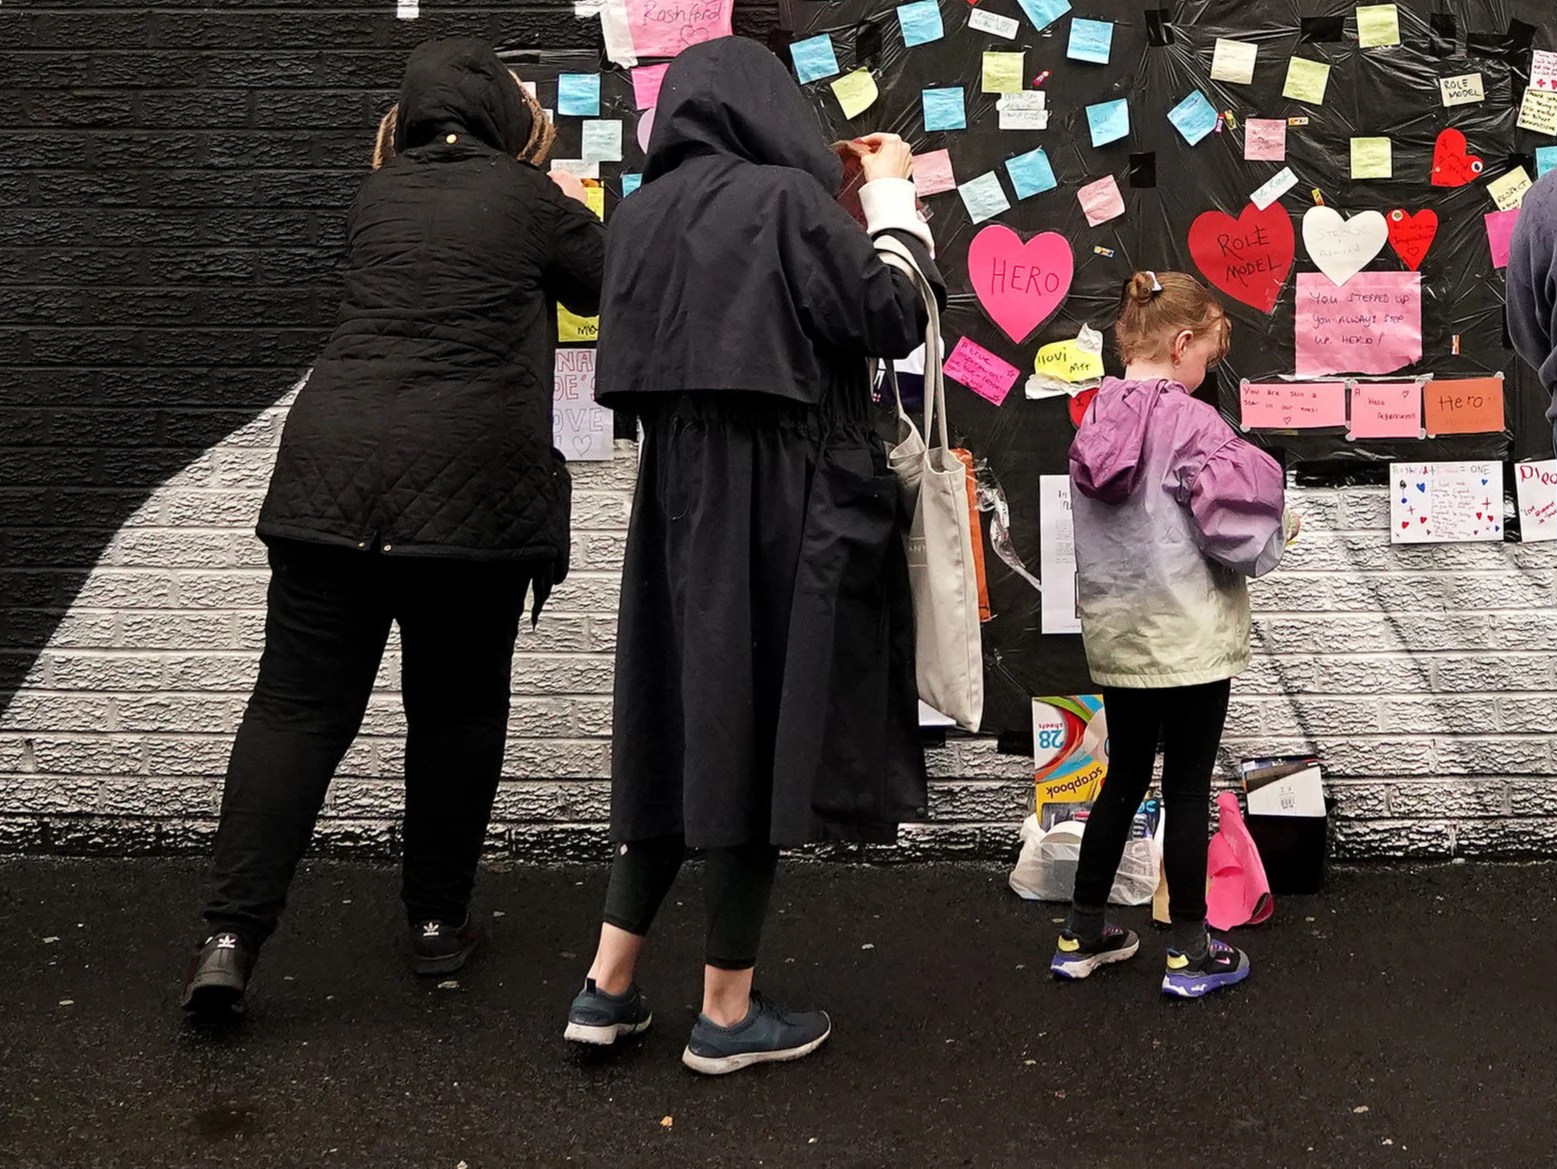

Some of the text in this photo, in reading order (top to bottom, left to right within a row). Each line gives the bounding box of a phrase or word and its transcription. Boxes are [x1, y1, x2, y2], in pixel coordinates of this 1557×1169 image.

[1444, 79, 1468, 89] ROLE
[1449, 89, 1481, 97] MODEL
[1217, 225, 1270, 259] ROLE
[992, 258, 1059, 296] HERO
[1226, 254, 1282, 287] MODEL
[1347, 293, 1389, 303] STEPPED
[1243, 387, 1259, 396] You
[1439, 394, 1483, 411] Hero
[1038, 730, 1064, 749] 28
[1046, 767, 1103, 794] scrapbook
